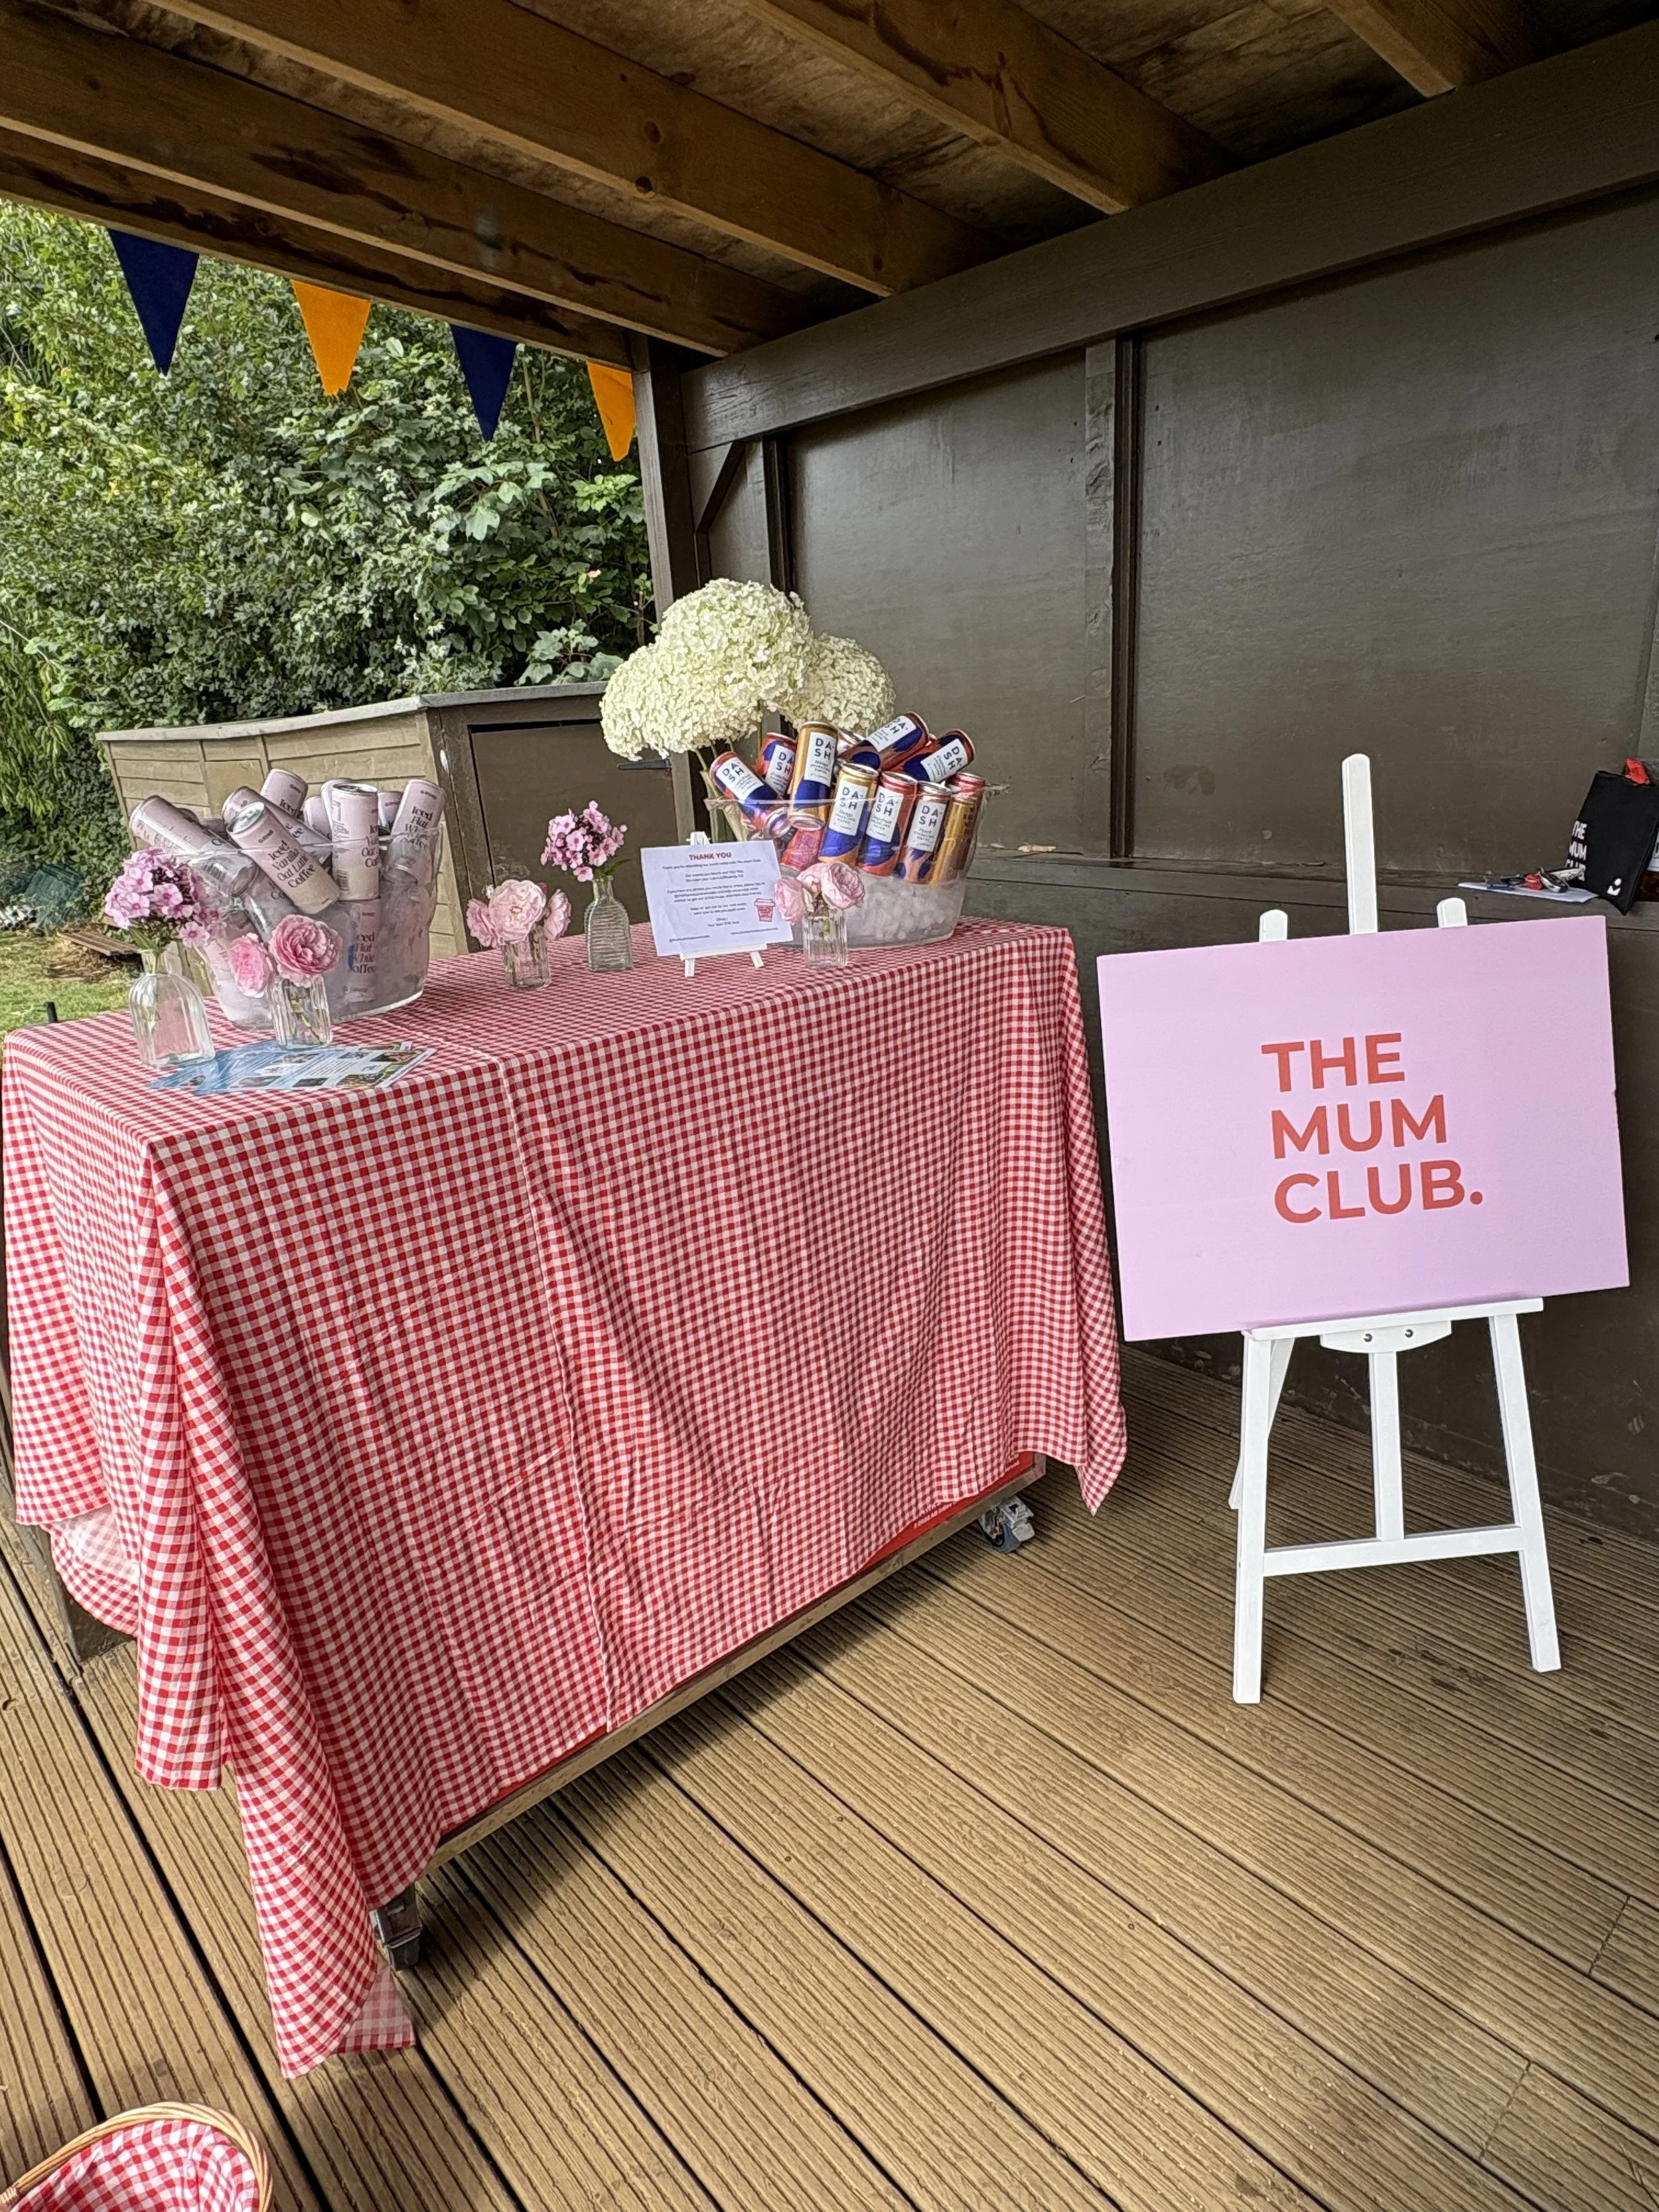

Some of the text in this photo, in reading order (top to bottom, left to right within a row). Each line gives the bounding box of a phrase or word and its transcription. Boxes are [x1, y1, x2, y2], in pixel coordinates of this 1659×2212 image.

[814, 748, 831, 761] SH
[944, 753, 956, 770] SH
[729, 768, 745, 782] SH
[775, 762, 791, 775] SH
[839, 798, 857, 810] SH
[876, 804, 893, 816] SH
[411, 806, 433, 821] Iced
[918, 816, 937, 828] SH
[1571, 820, 1588, 840] THE
[267, 839, 291, 861] Iced
[689, 853, 715, 861] THANK
[1569, 840, 1588, 861] MUM
[277, 868, 294, 881] Oat
[287, 864, 316, 888] Coffee
[1261, 1033, 1405, 1092] THE
[1271, 1094, 1447, 1159] MUM
[1274, 1159, 1483, 1224] CLUB.
